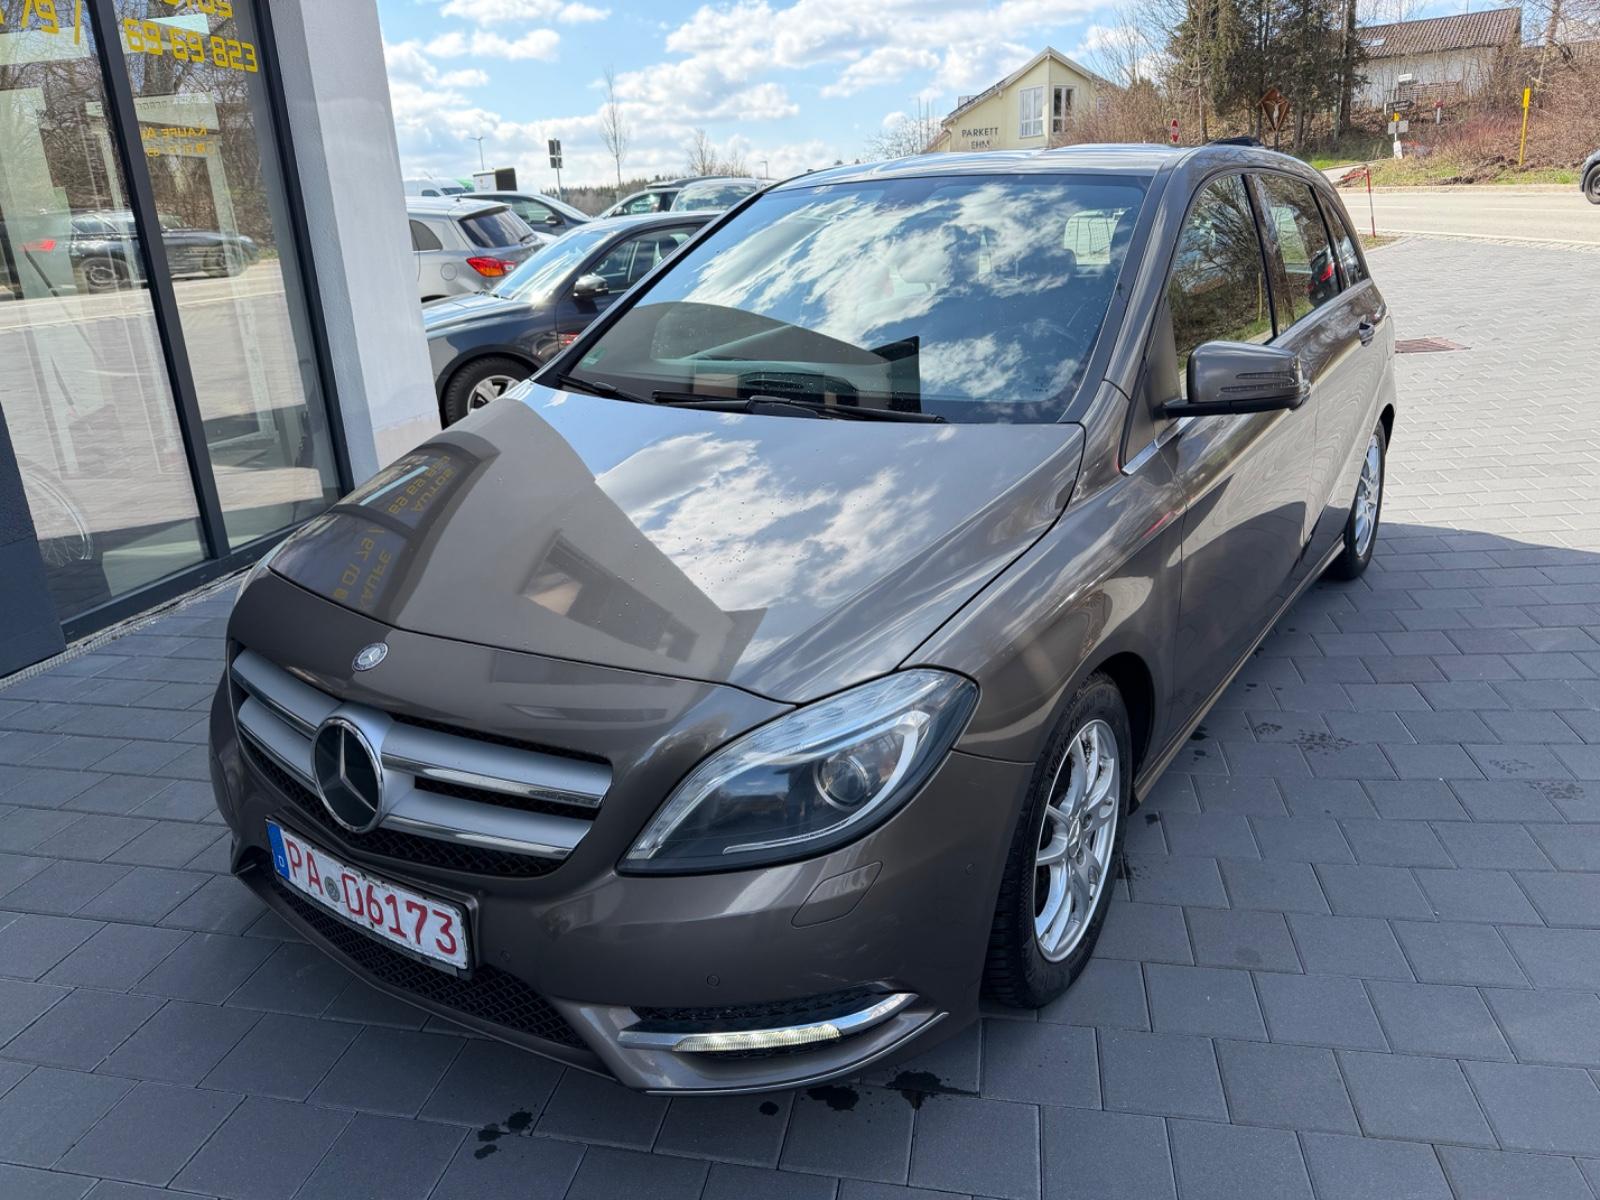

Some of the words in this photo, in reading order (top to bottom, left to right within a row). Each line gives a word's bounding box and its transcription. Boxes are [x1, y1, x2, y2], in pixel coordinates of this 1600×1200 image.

[124, 18, 163, 55] 69
[169, 28, 204, 62] 69
[210, 35, 258, 72] 823
[961, 127, 998, 137] PARKETT
[285, 838, 324, 895] PA
